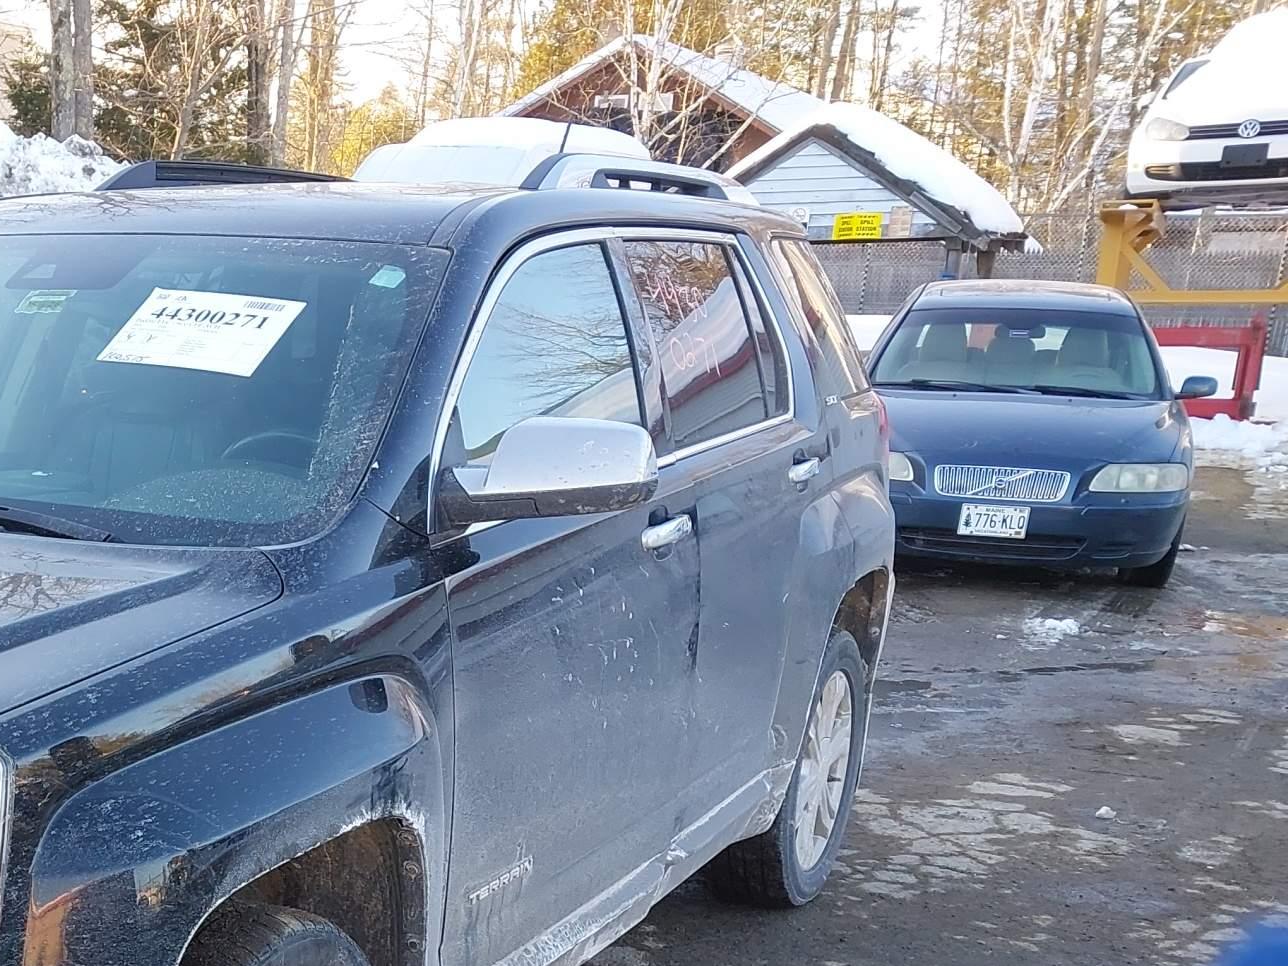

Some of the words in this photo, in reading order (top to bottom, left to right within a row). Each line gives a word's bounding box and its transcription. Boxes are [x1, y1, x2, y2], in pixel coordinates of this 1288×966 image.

[151, 306, 270, 329] 44300271
[670, 332, 721, 377] 0271
[469, 856, 533, 904] TERRAIN
